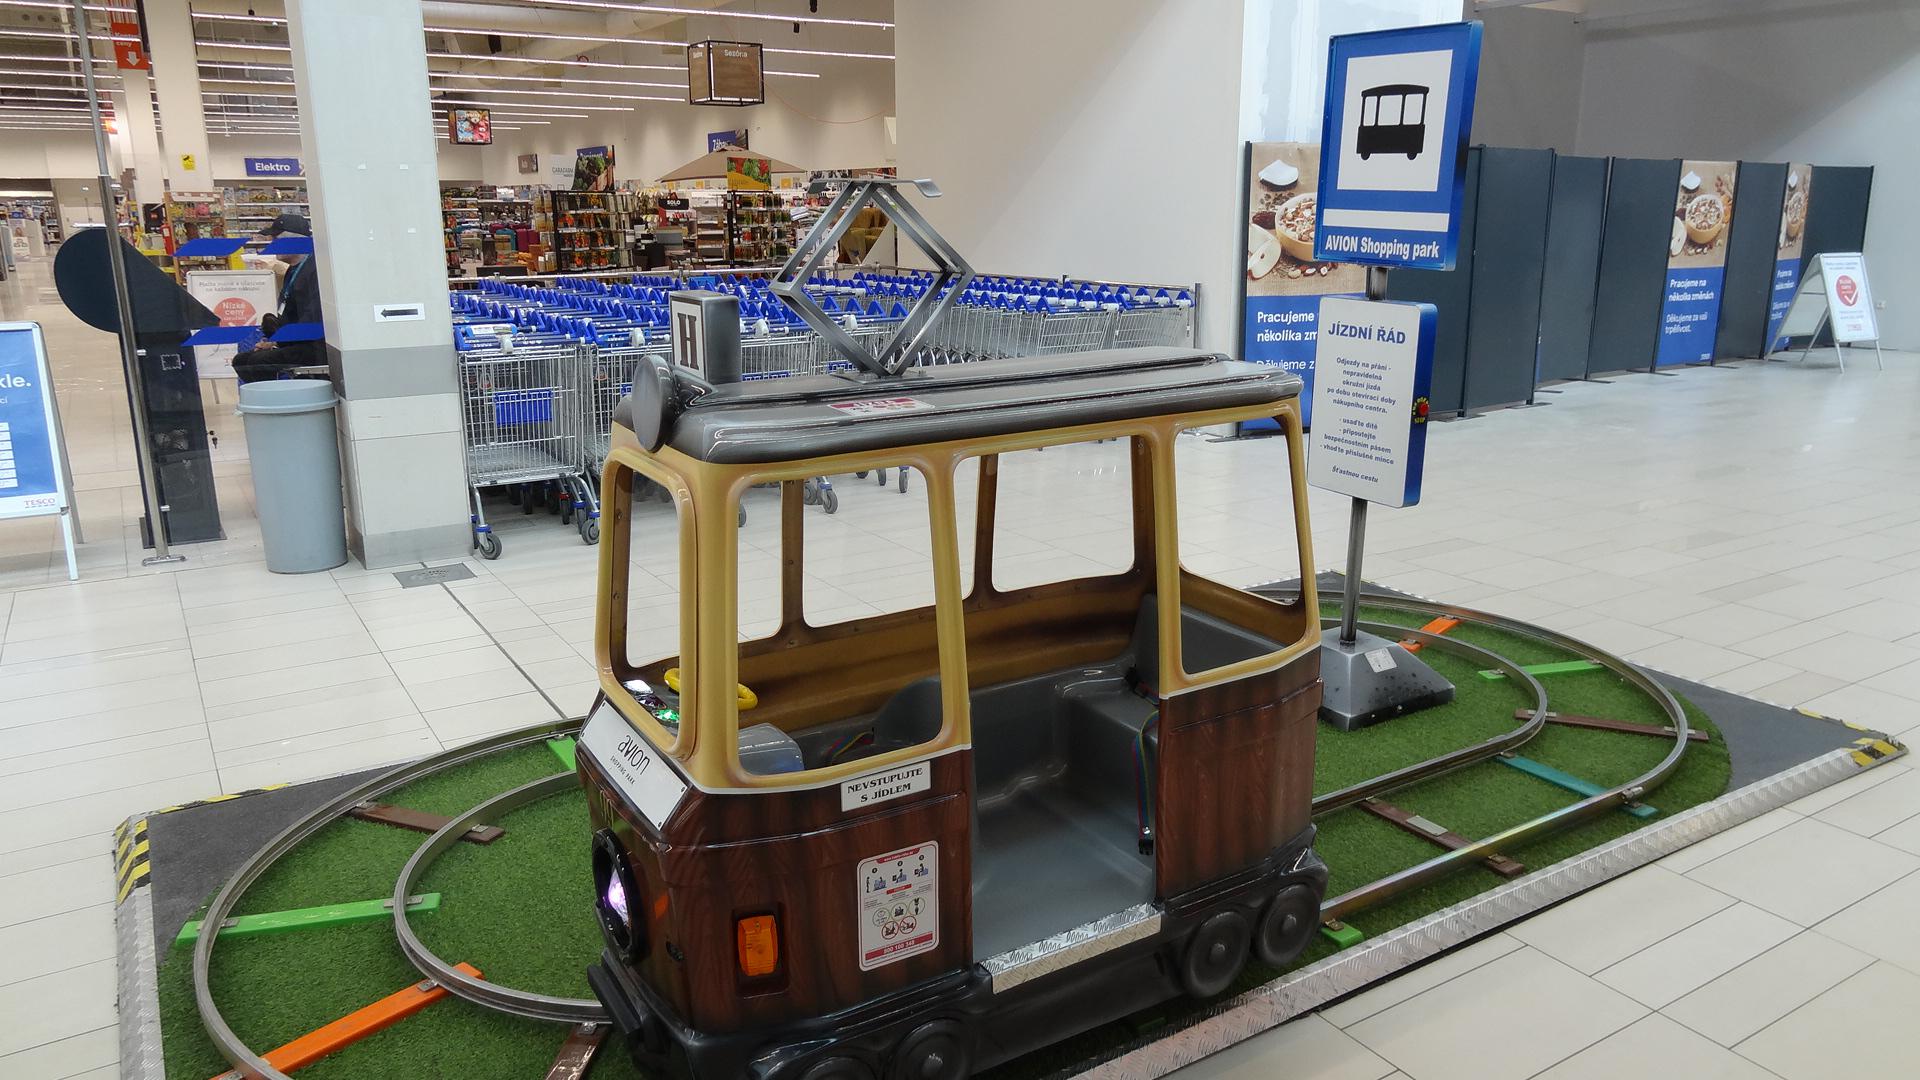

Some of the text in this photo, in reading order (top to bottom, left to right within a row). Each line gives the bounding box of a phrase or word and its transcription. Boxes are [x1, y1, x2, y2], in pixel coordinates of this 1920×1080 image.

[255, 162, 291, 171] Elektro
[1325, 235, 1440, 260] AVION Shopping park
[1257, 311, 1315, 325] Pracujeme
[677, 312, 699, 370] H
[1257, 329, 1302, 342] několika
[1328, 321, 1373, 340] JÍZDNÍ
[1376, 326, 1406, 344] ŘÁD
[1336, 357, 1361, 368] Odjezdy
[1335, 388, 1351, 397] dobu
[1380, 396, 1397, 405] doby
[24, 498, 56, 509] TESCO
[617, 735, 651, 775] avion
[847, 767, 923, 794] NEVSTUPUJTE
[860, 783, 911, 803] S JÍDLEM
